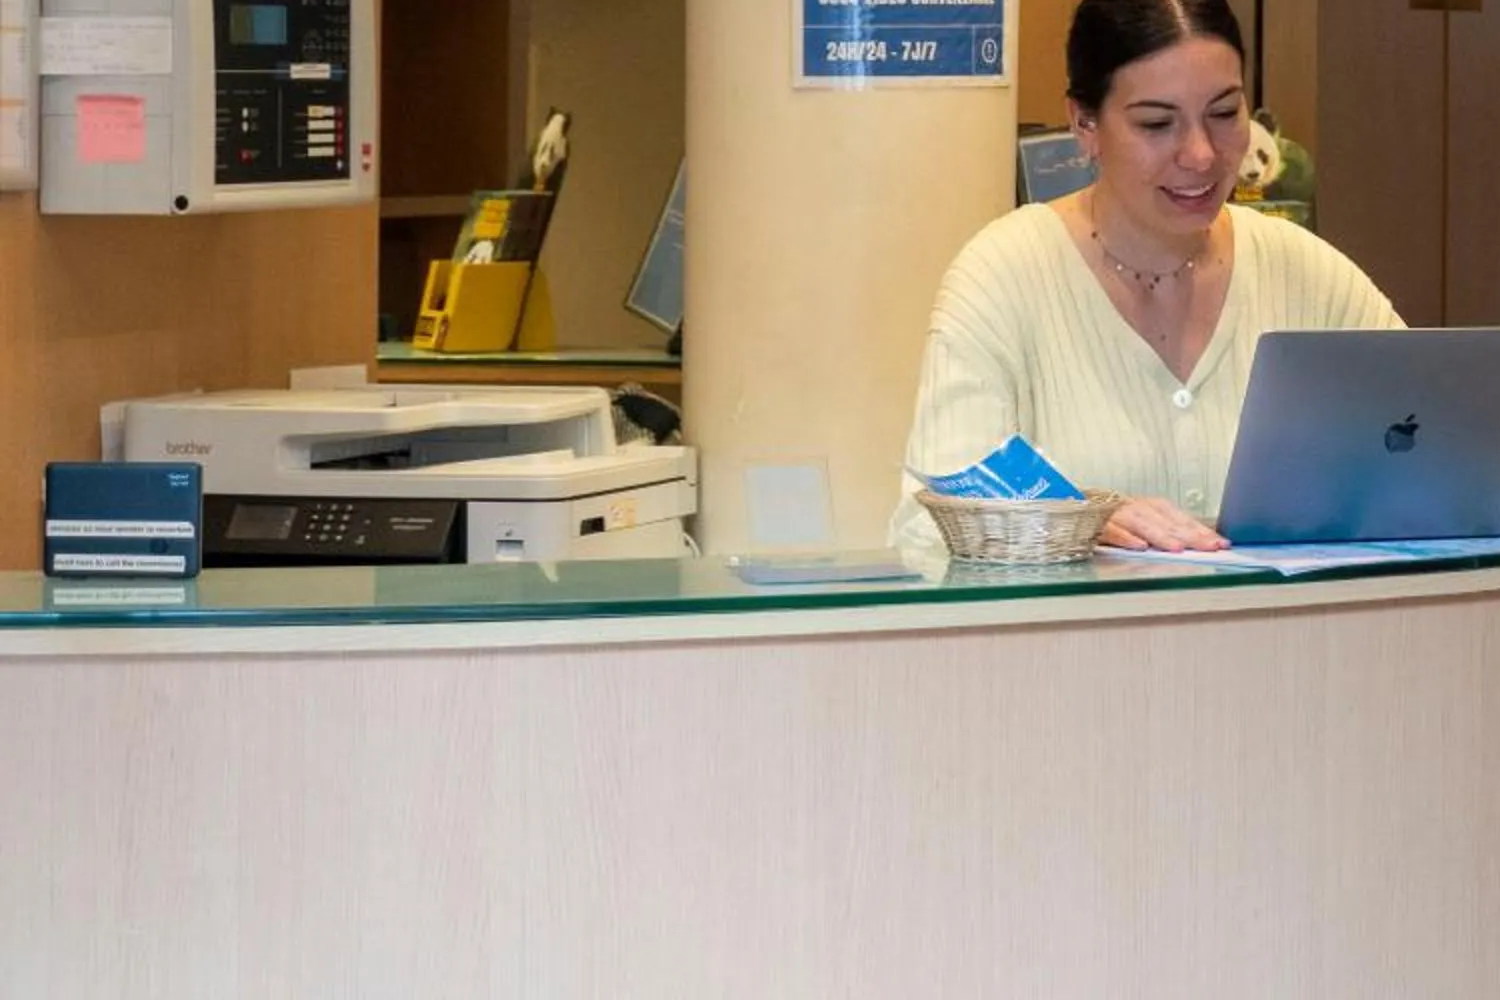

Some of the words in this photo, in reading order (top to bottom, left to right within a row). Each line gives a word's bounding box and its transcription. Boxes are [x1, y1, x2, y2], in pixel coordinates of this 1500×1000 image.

[826, 41, 887, 61] 24H/24
[902, 41, 937, 61] 7J/7
[165, 439, 212, 455] brother
